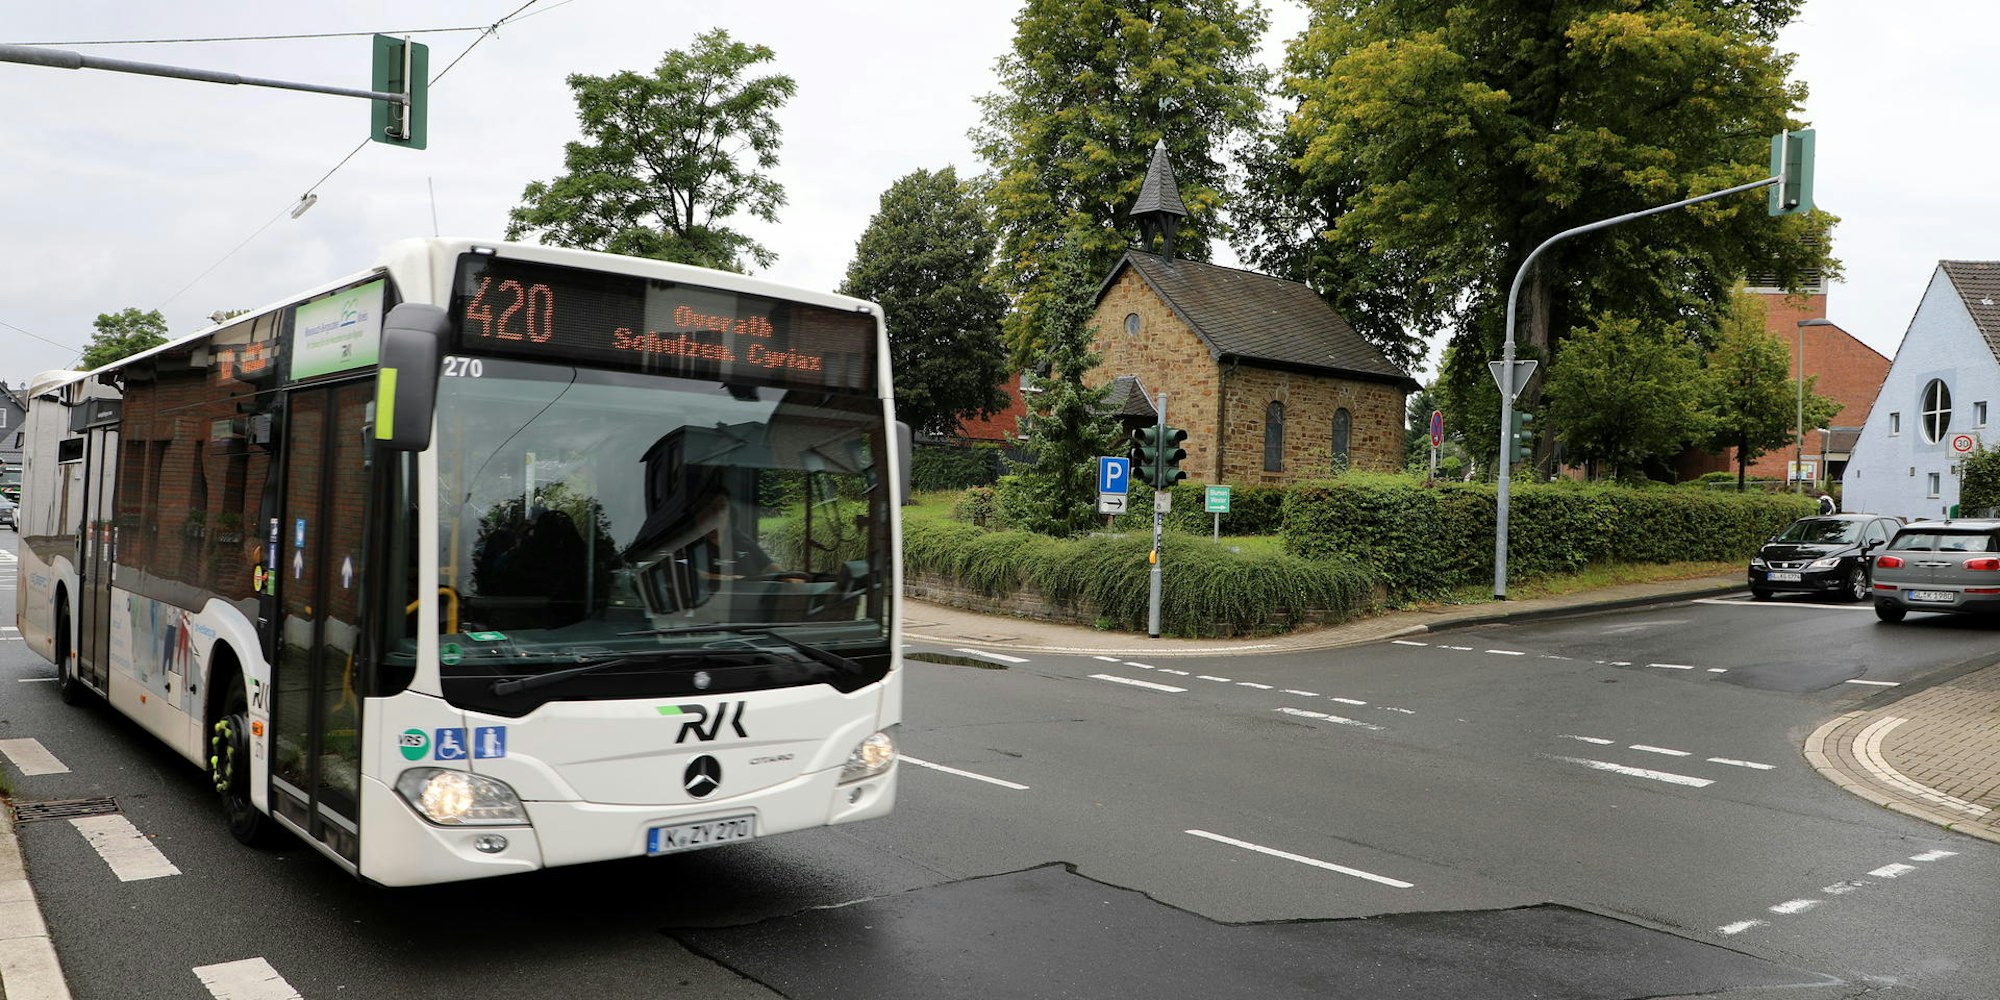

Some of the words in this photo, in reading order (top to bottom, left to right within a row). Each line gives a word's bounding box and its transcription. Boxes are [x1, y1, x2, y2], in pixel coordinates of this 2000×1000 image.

[467, 276, 555, 344] 420
[672, 305, 774, 338] Overath
[443, 355, 483, 378] 270
[1957, 439, 1969, 448] 30
[1106, 461, 1123, 489] P
[399, 734, 422, 747] VRS
[664, 829, 678, 848] K
[691, 823, 714, 845] ZY
[716, 819, 749, 841] 270
